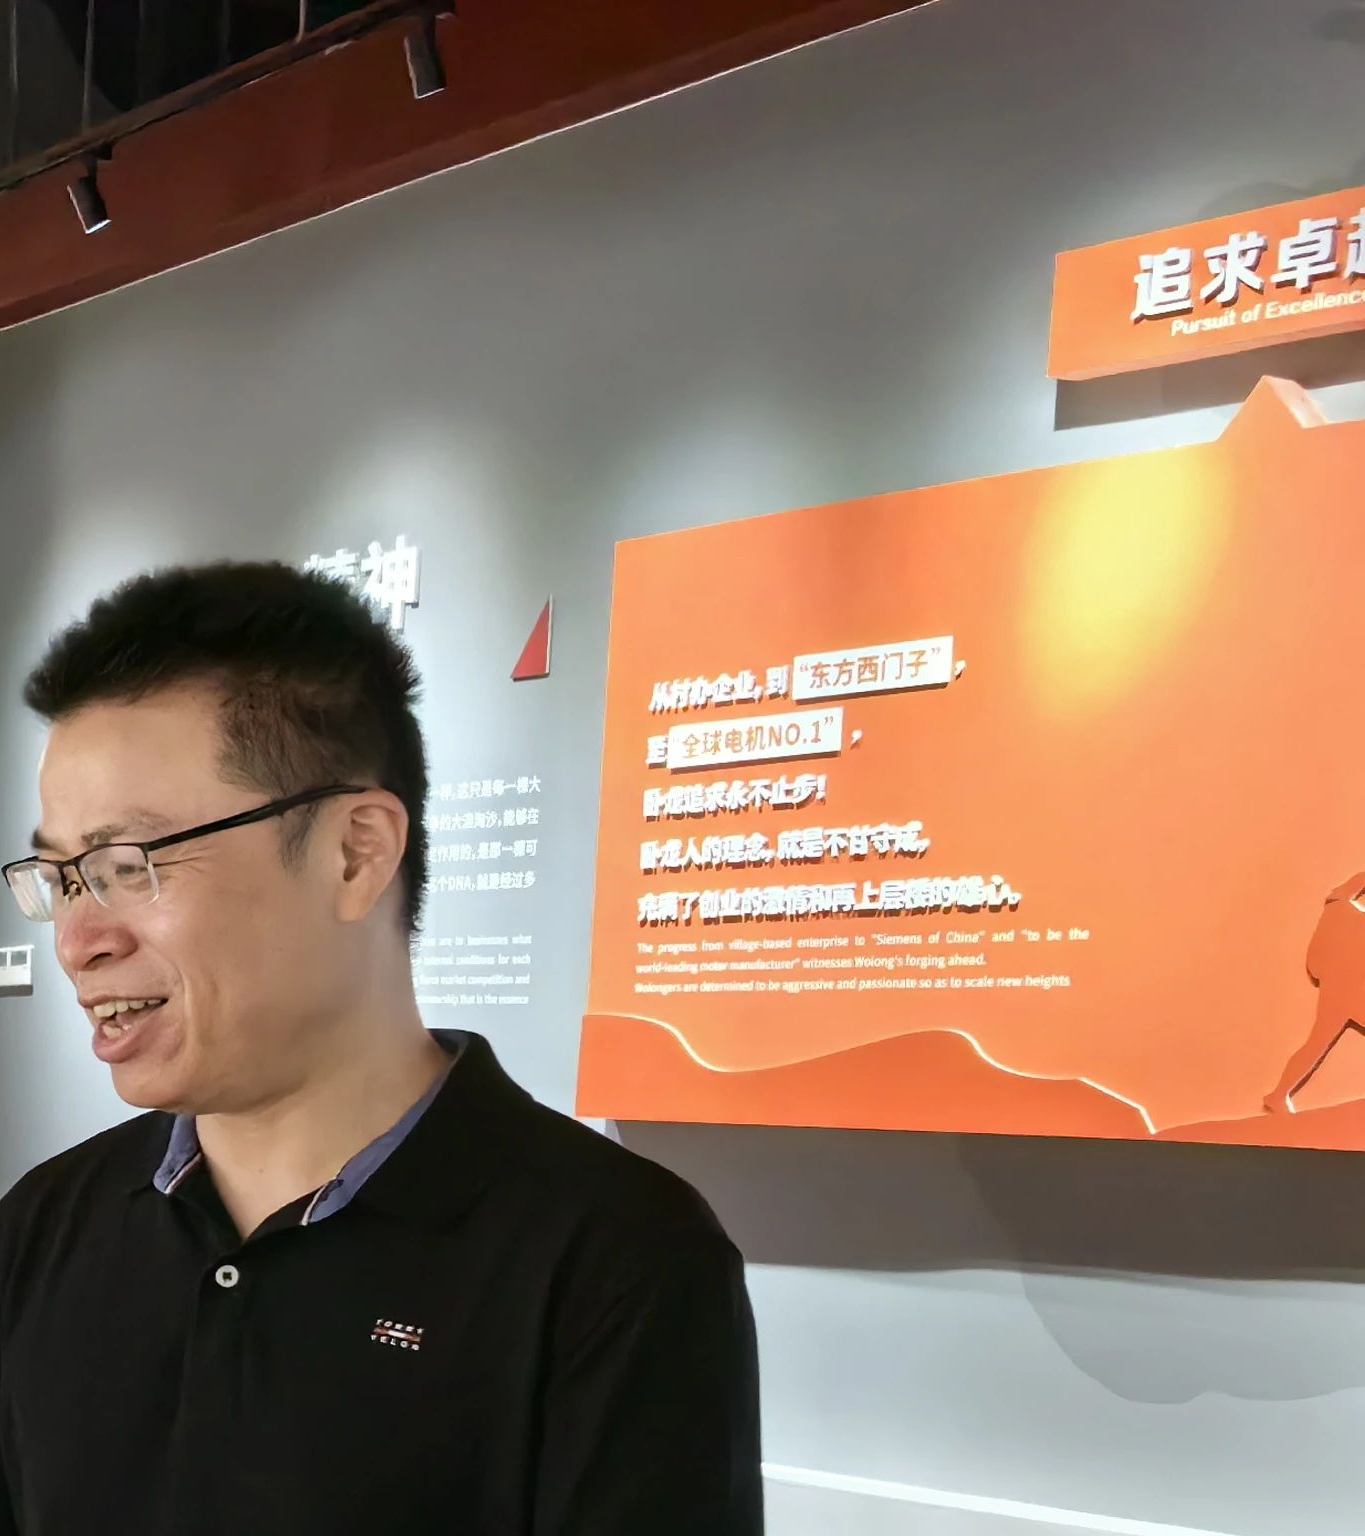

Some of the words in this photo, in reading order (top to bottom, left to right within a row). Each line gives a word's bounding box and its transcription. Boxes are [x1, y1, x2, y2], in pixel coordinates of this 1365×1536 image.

[1171, 309, 1237, 336] Pursuit
[1241, 303, 1262, 324] of
[637, 942, 653, 953] The
[657, 943, 697, 956] progress
[702, 940, 724, 951] from
[728, 937, 792, 952] village-based
[797, 937, 849, 949] enterprise
[855, 935, 865, 946] to
[928, 931, 940, 943] of
[991, 929, 1014, 942] and
[1046, 928, 1062, 941] be
[1069, 928, 1089, 940] the
[803, 957, 852, 969] witnesses
[905, 953, 946, 969] forging
[947, 953, 987, 966] ahead.
[683, 984, 698, 993] are
[699, 981, 753, 993] determined
[755, 981, 766, 992] to
[768, 980, 780, 991] be
[782, 979, 834, 993] aggressive
[837, 978, 856, 989] and
[859, 977, 917, 990] passionate
[919, 979, 932, 989] so
[934, 979, 947, 988] as
[950, 977, 962, 988] to
[965, 975, 994, 988] scale
[997, 977, 1023, 987] new
